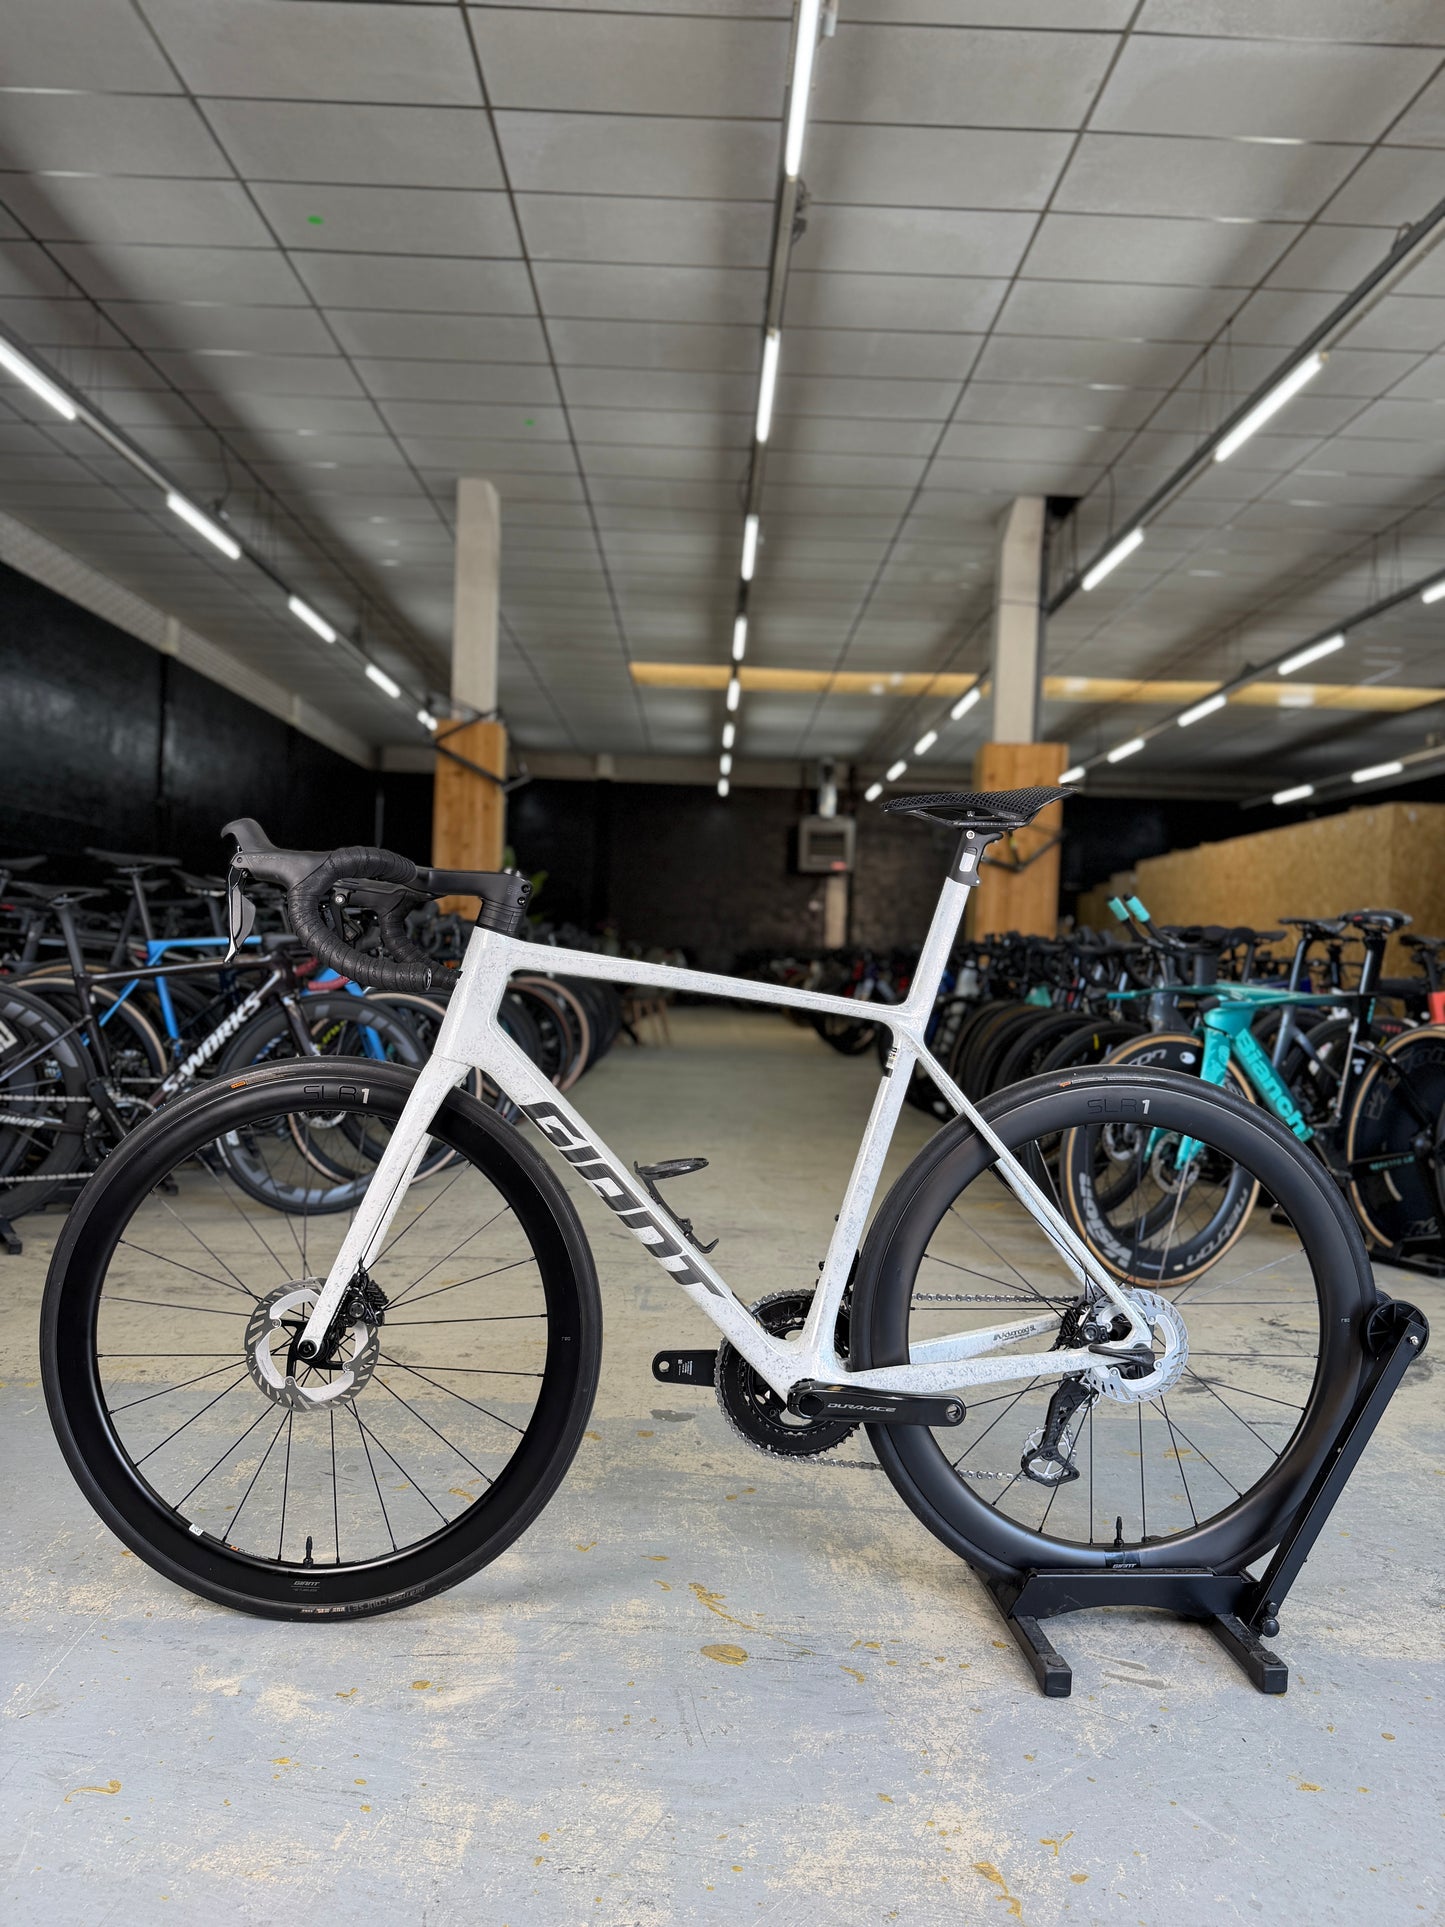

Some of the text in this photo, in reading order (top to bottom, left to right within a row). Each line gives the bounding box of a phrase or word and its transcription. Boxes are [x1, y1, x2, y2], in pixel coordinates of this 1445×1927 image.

[162, 990, 261, 1099] S-WORKS
[1235, 1028, 1315, 1142] Bianchi
[518, 1101, 728, 1299] GIANT
[827, 1402, 897, 1413] DURA-ACE
